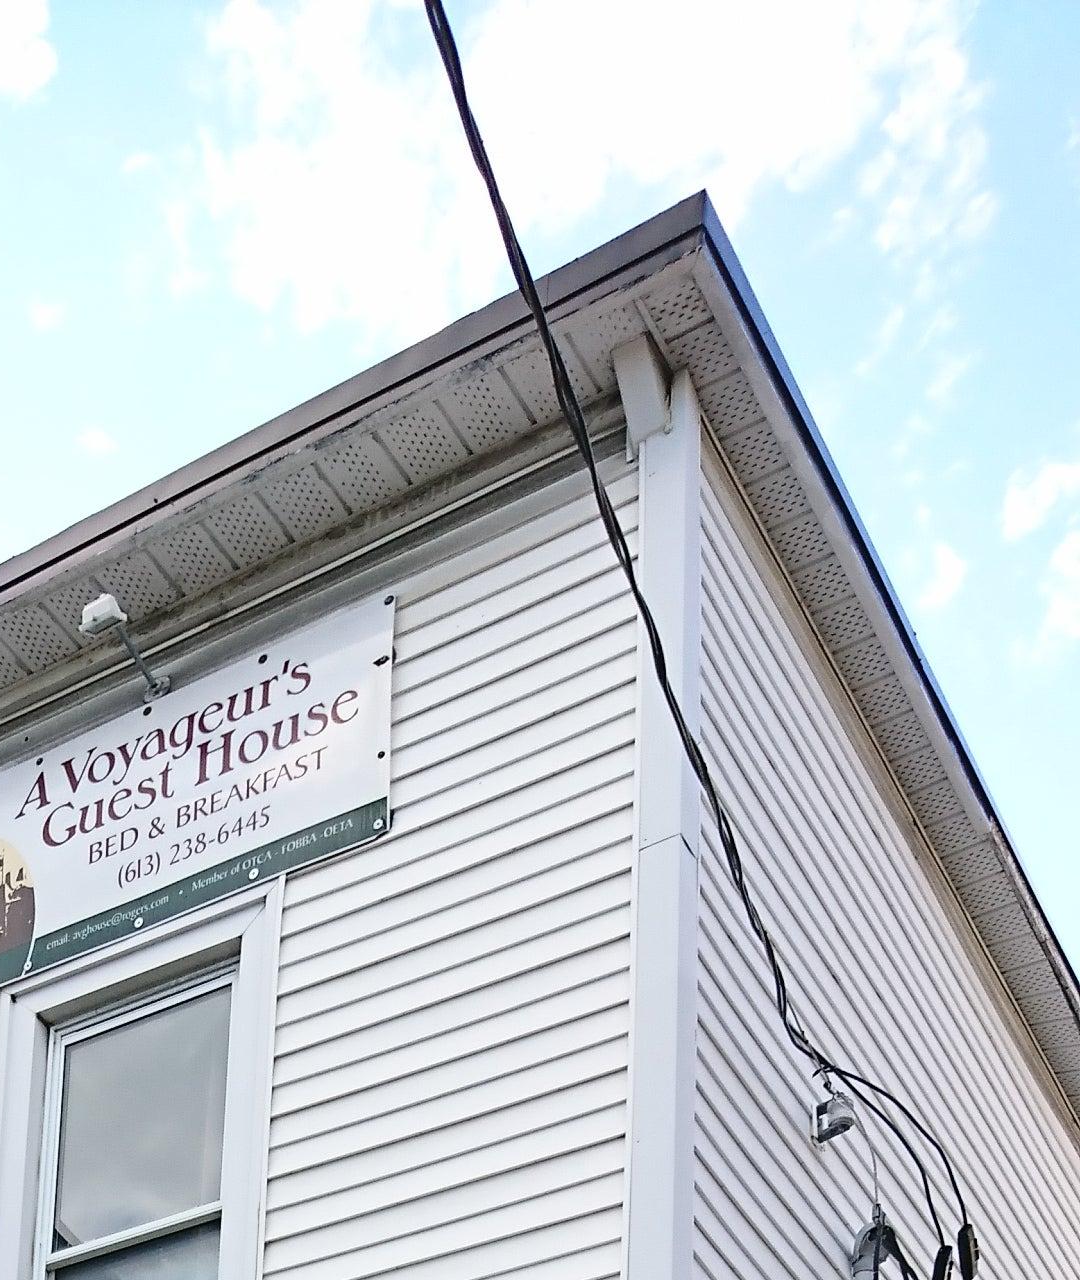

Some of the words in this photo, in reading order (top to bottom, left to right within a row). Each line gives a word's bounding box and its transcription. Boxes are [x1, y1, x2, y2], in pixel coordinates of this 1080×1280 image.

[15, 771, 51, 820] A
[61, 660, 312, 798] Voyageur's
[42, 762, 174, 849] Guest
[195, 690, 359, 785] House
[88, 829, 138, 865] BED
[148, 817, 165, 839] &
[176, 746, 329, 829] BREAKFAST
[117, 852, 160, 889] (613)
[169, 806, 271, 866] 238-6445
[46, 933, 70, 950] email:
[72, 895, 169, 939] avghouse@rogers.com
[191, 869, 228, 892] Member
[231, 862, 242, 876] of
